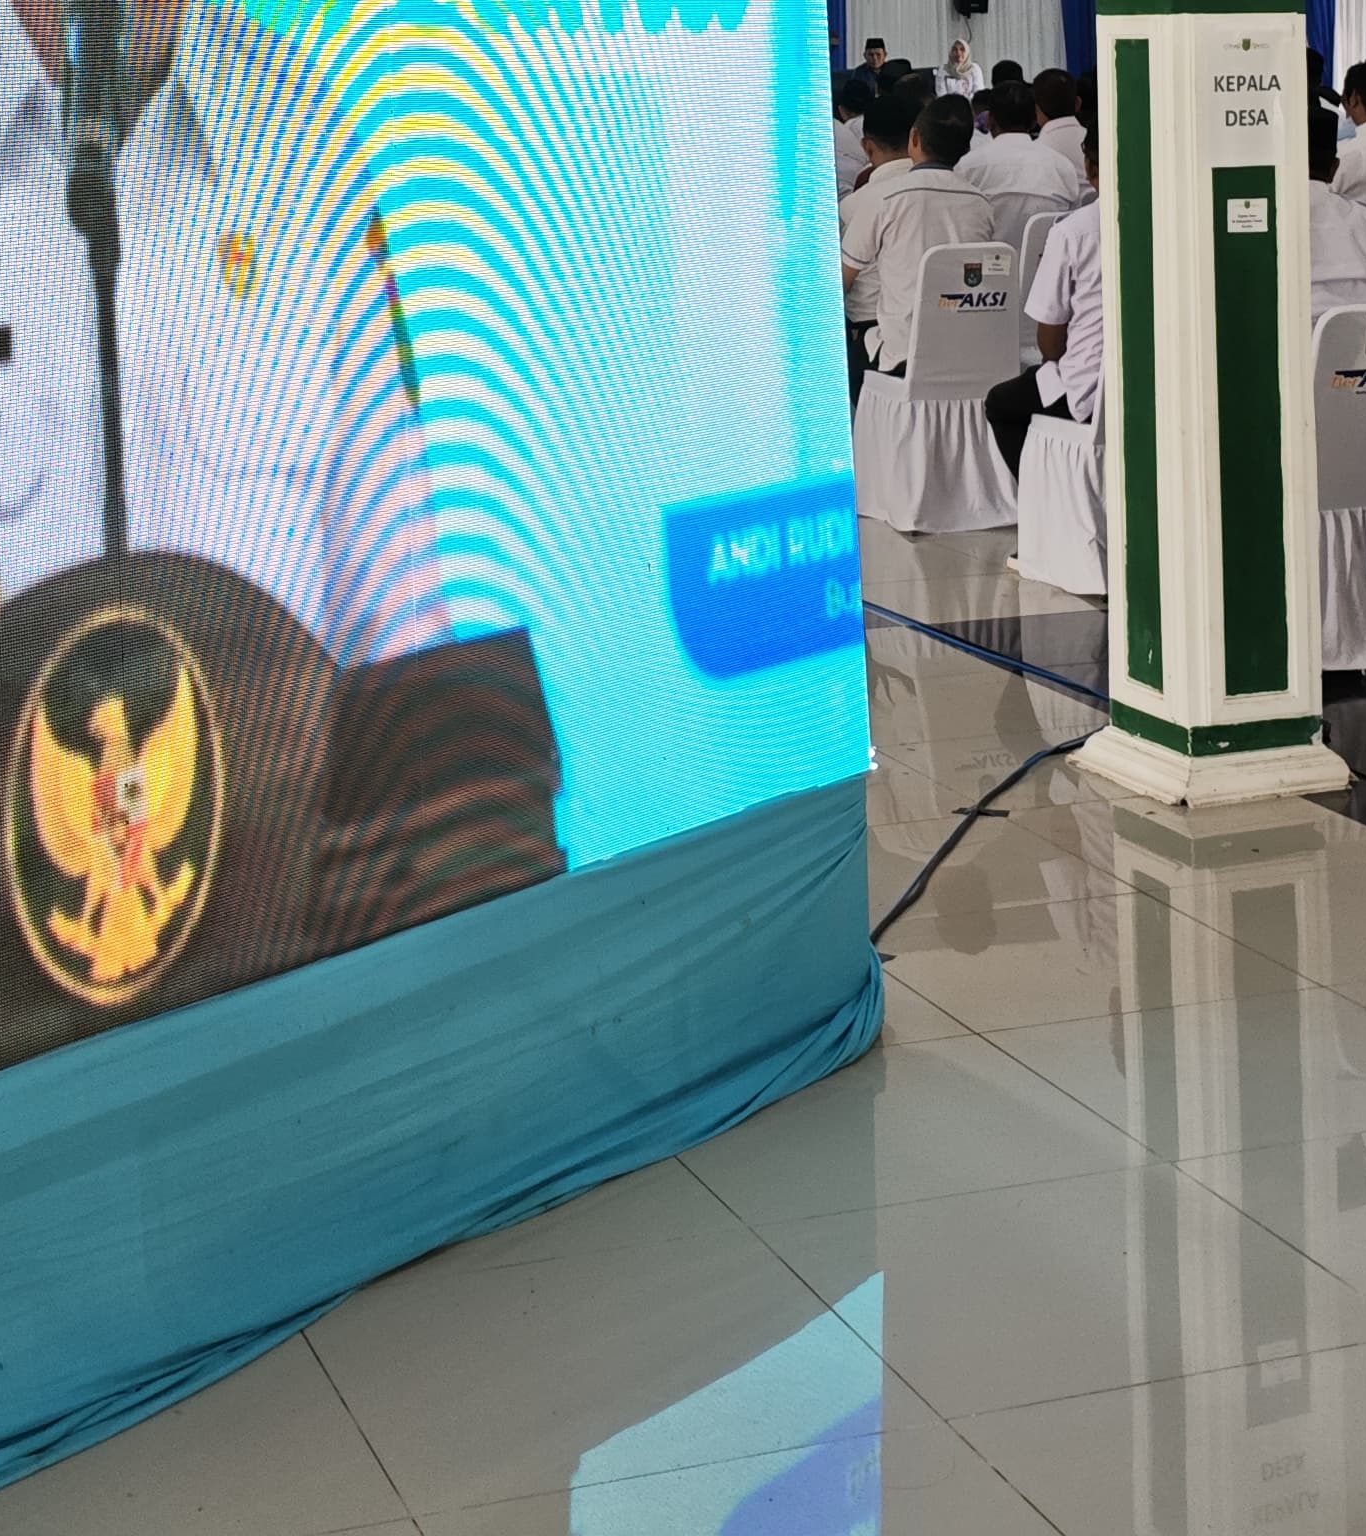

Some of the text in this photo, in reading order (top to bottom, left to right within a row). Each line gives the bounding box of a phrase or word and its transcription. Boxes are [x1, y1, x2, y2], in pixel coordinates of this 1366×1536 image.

[1213, 74, 1281, 92] KEPALA
[1225, 108, 1269, 127] DESA
[706, 521, 782, 585] ANDI
